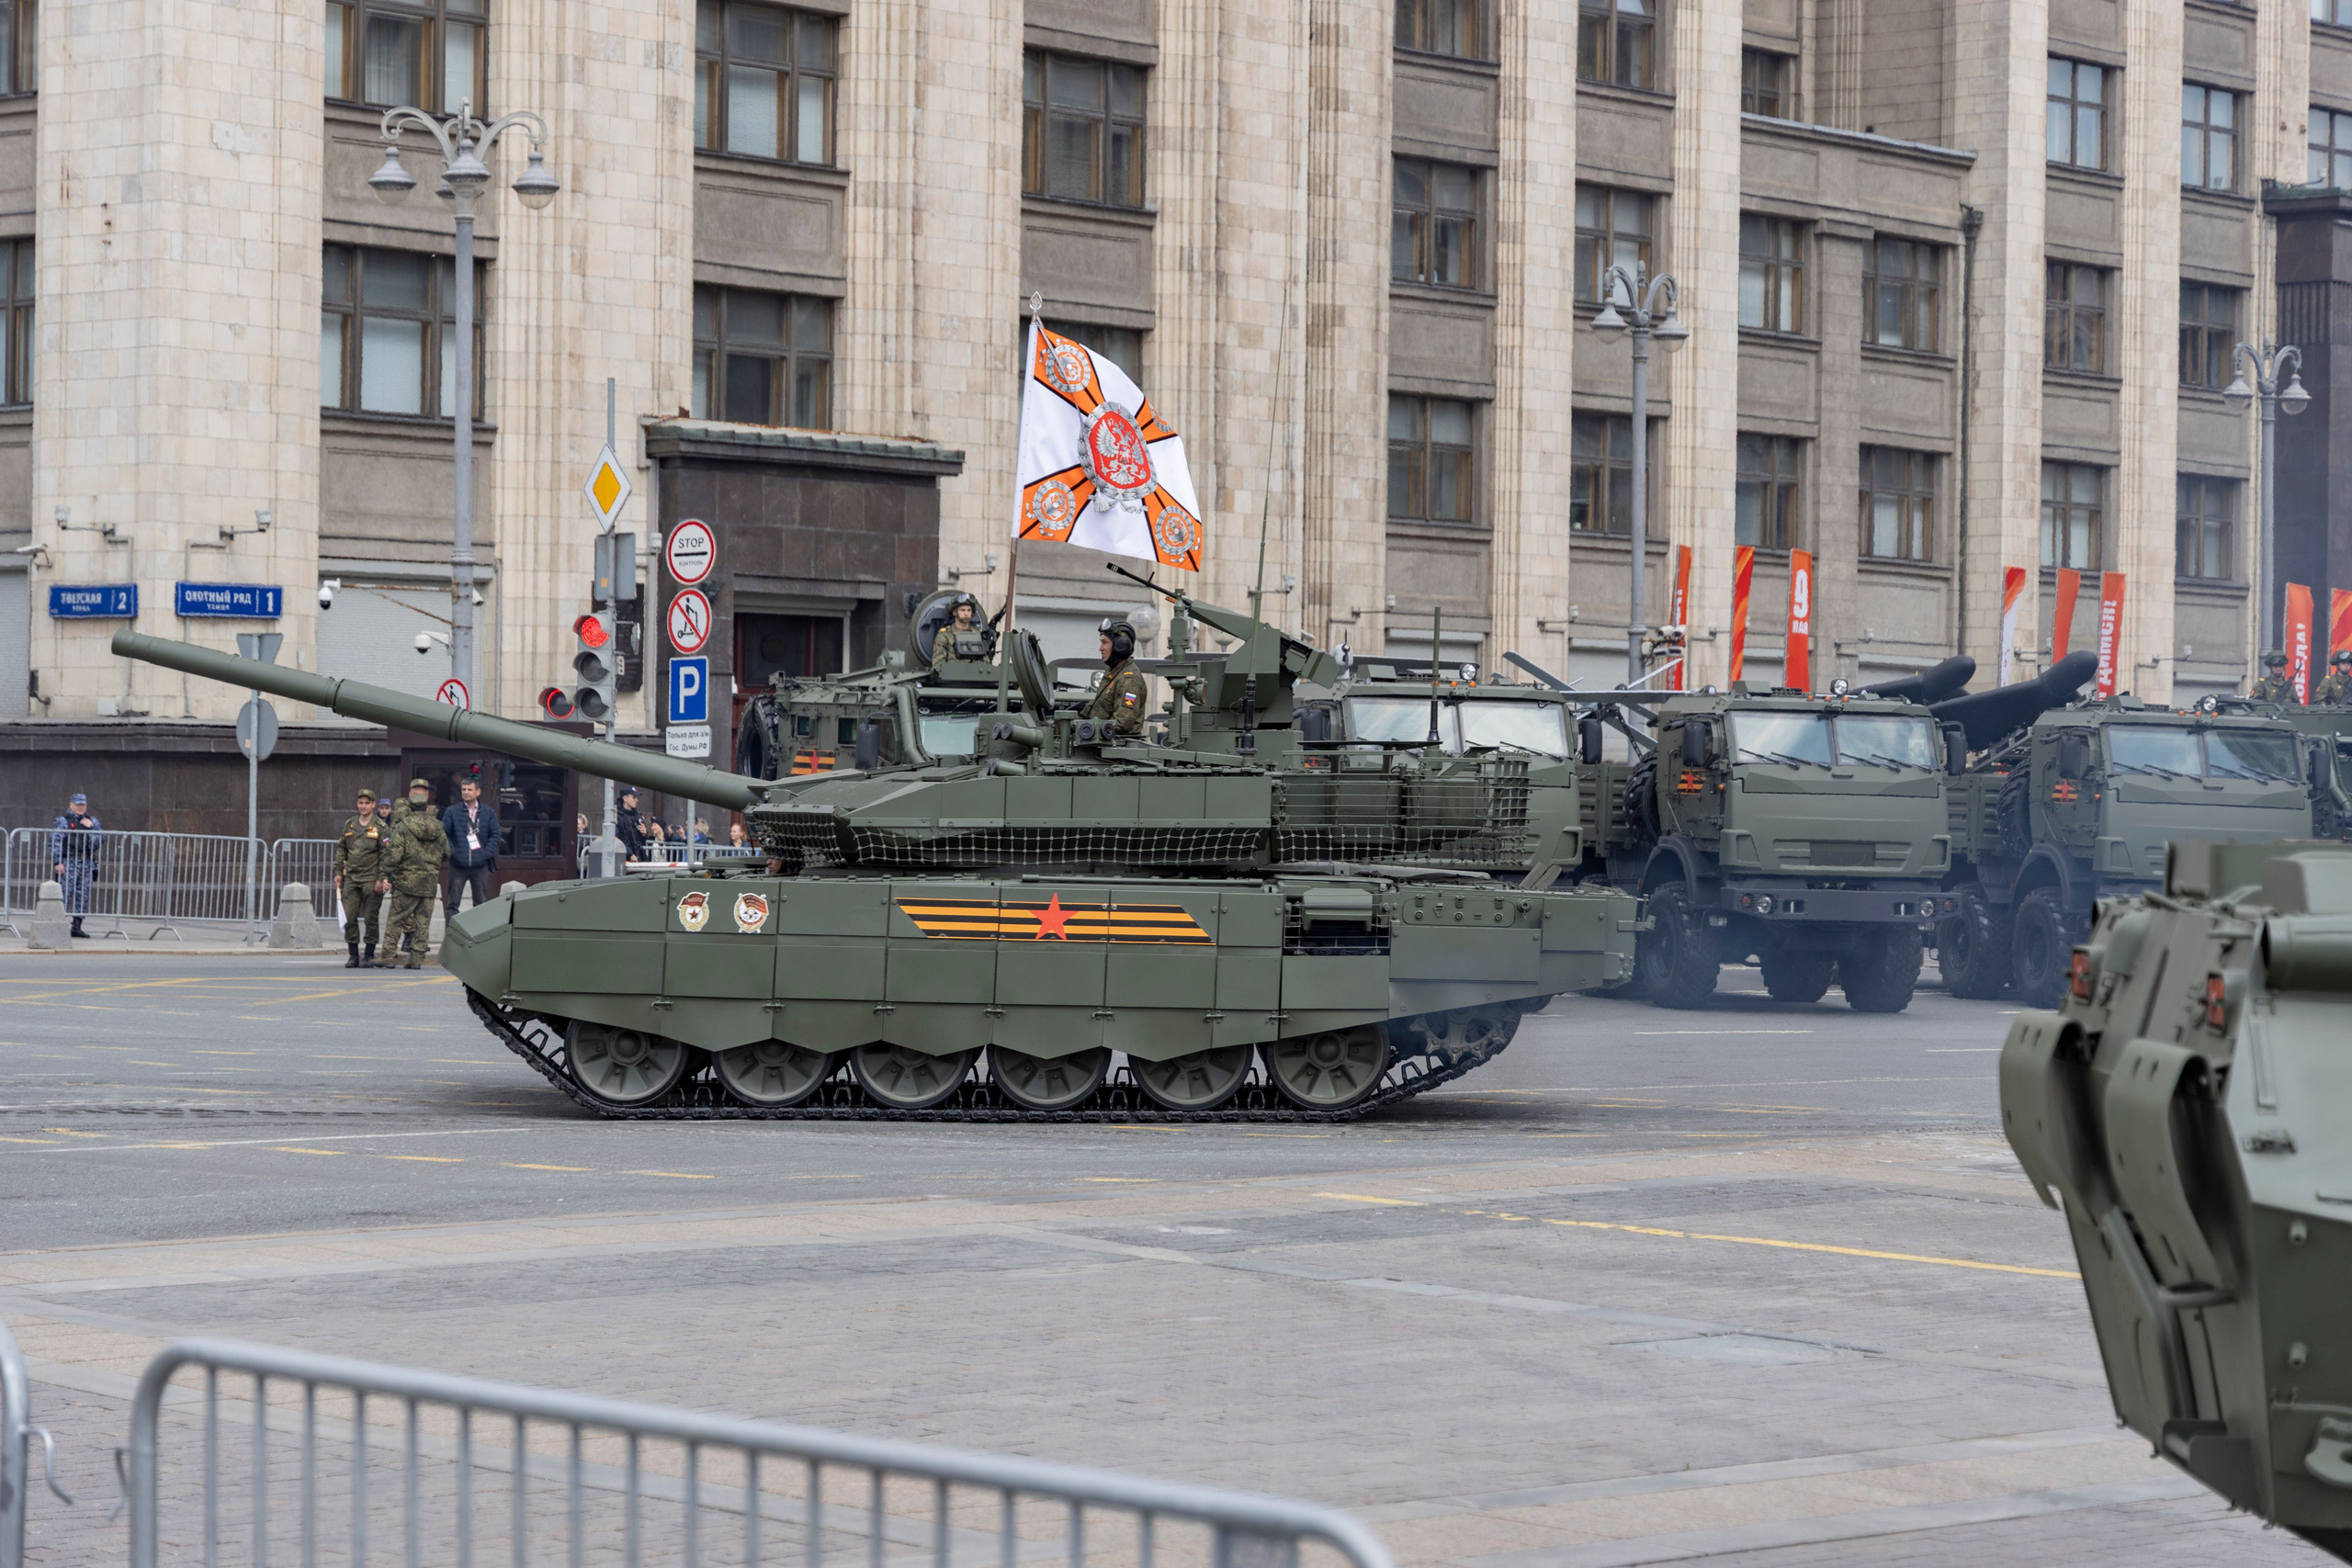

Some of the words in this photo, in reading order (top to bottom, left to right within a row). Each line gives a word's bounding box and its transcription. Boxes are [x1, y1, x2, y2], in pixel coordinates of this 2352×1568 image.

[678, 537, 704, 548] STOP
[61, 592, 102, 604] ТВЕРСКАЯ
[118, 592, 128, 611] 2
[185, 590, 232, 604] ОХОТНЫЙ
[233, 592, 252, 605] РЯД
[266, 591, 274, 613] 1
[1792, 569, 1809, 619] 9
[1792, 619, 1808, 635] МАЯ
[2295, 623, 2308, 705] ОБЕДА!
[679, 666, 701, 714] P
[681, 743, 698, 752] Думы
